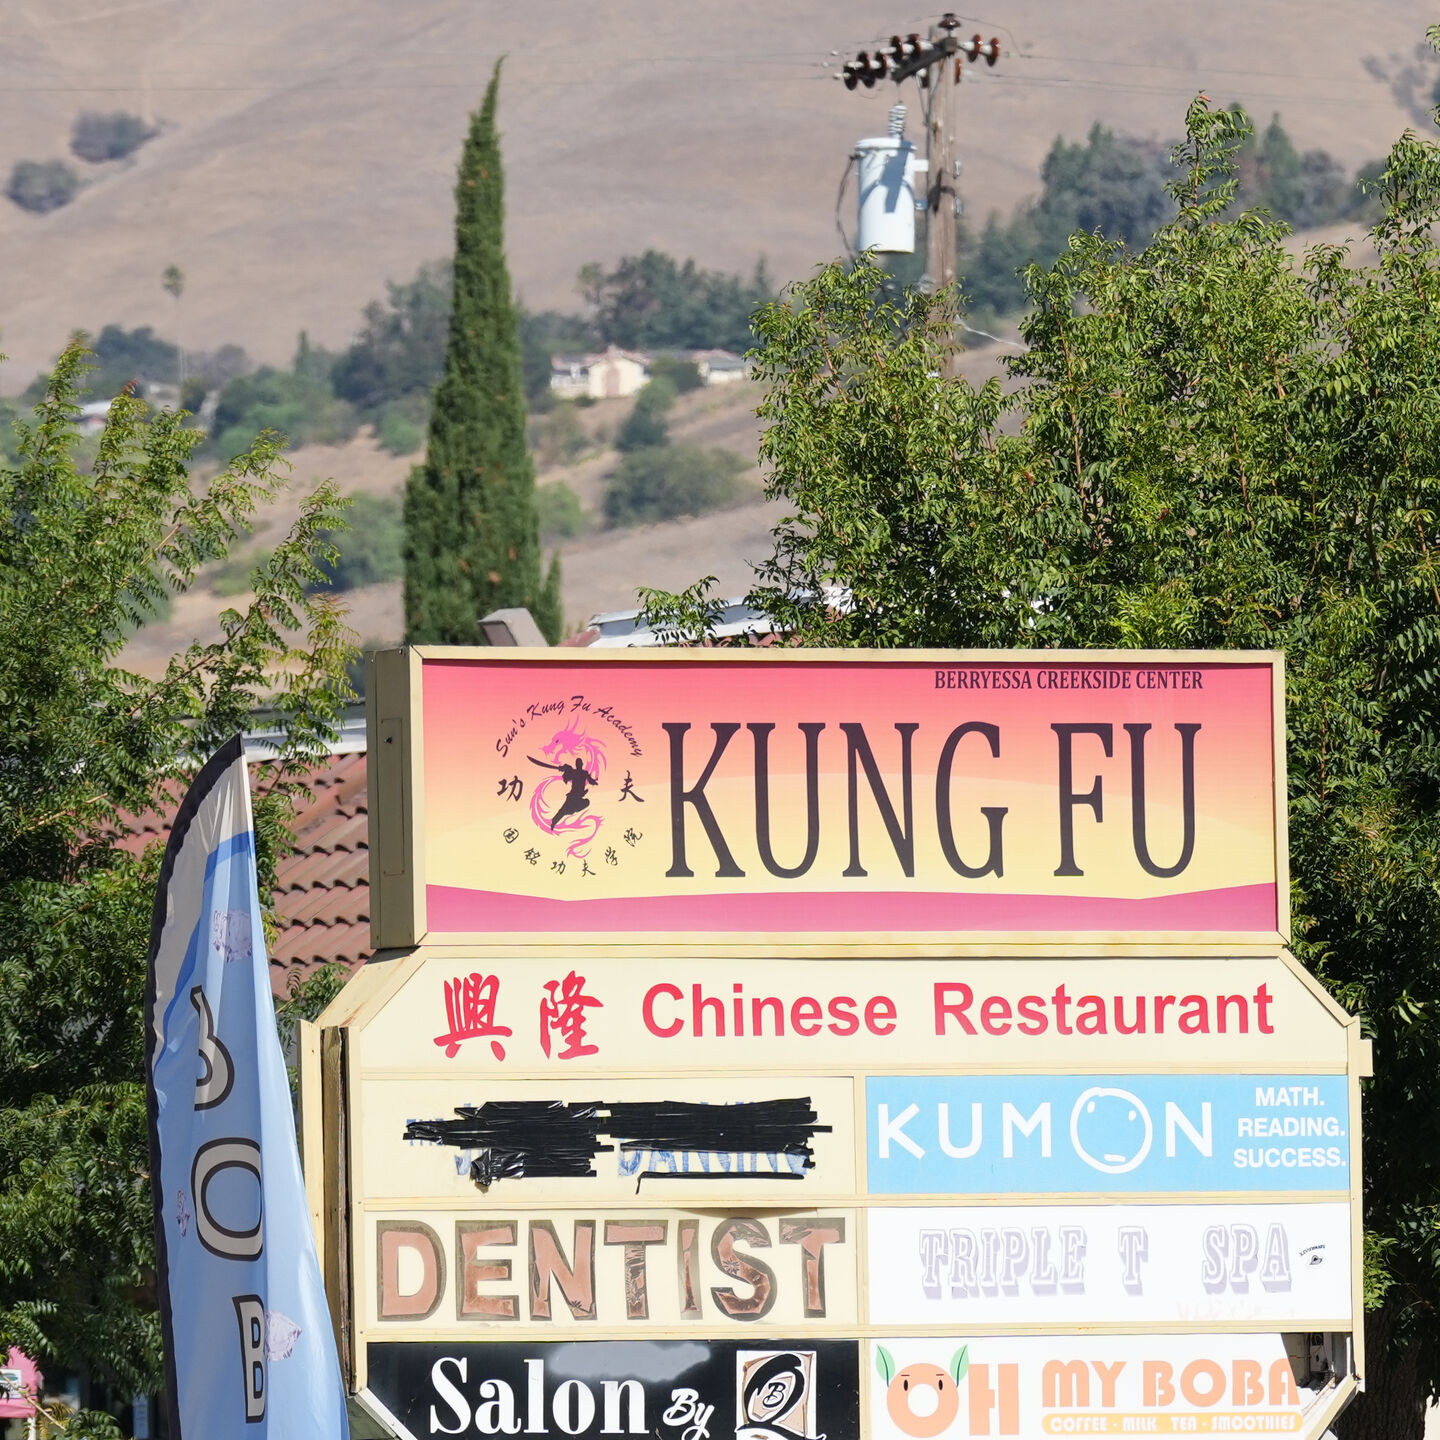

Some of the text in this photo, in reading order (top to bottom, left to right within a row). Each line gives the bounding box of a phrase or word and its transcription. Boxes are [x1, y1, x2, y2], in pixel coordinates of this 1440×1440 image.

[934, 670, 1203, 689] BERRYESSA CREEKSIDE CENTER
[496, 695, 643, 758] Sun's Kung Fu Academy
[661, 721, 1202, 879] KUNG FU
[642, 982, 1275, 1038] Chinese Restaurant
[1237, 1116, 1347, 1138] READING.
[1255, 1086, 1326, 1107] MATH.
[878, 1086, 1213, 1175] KUMON
[1233, 1147, 1347, 1168] SUCCESS.
[376, 1217, 846, 1321] DENTIST
[918, 1223, 1292, 1299] TRIPLE T SPA
[429, 1356, 650, 1435] Salon
[886, 1358, 1301, 1439] OH MY BOBA
[1049, 1414, 1296, 1433] COFFEE MILK TEA SMOOTHIES
